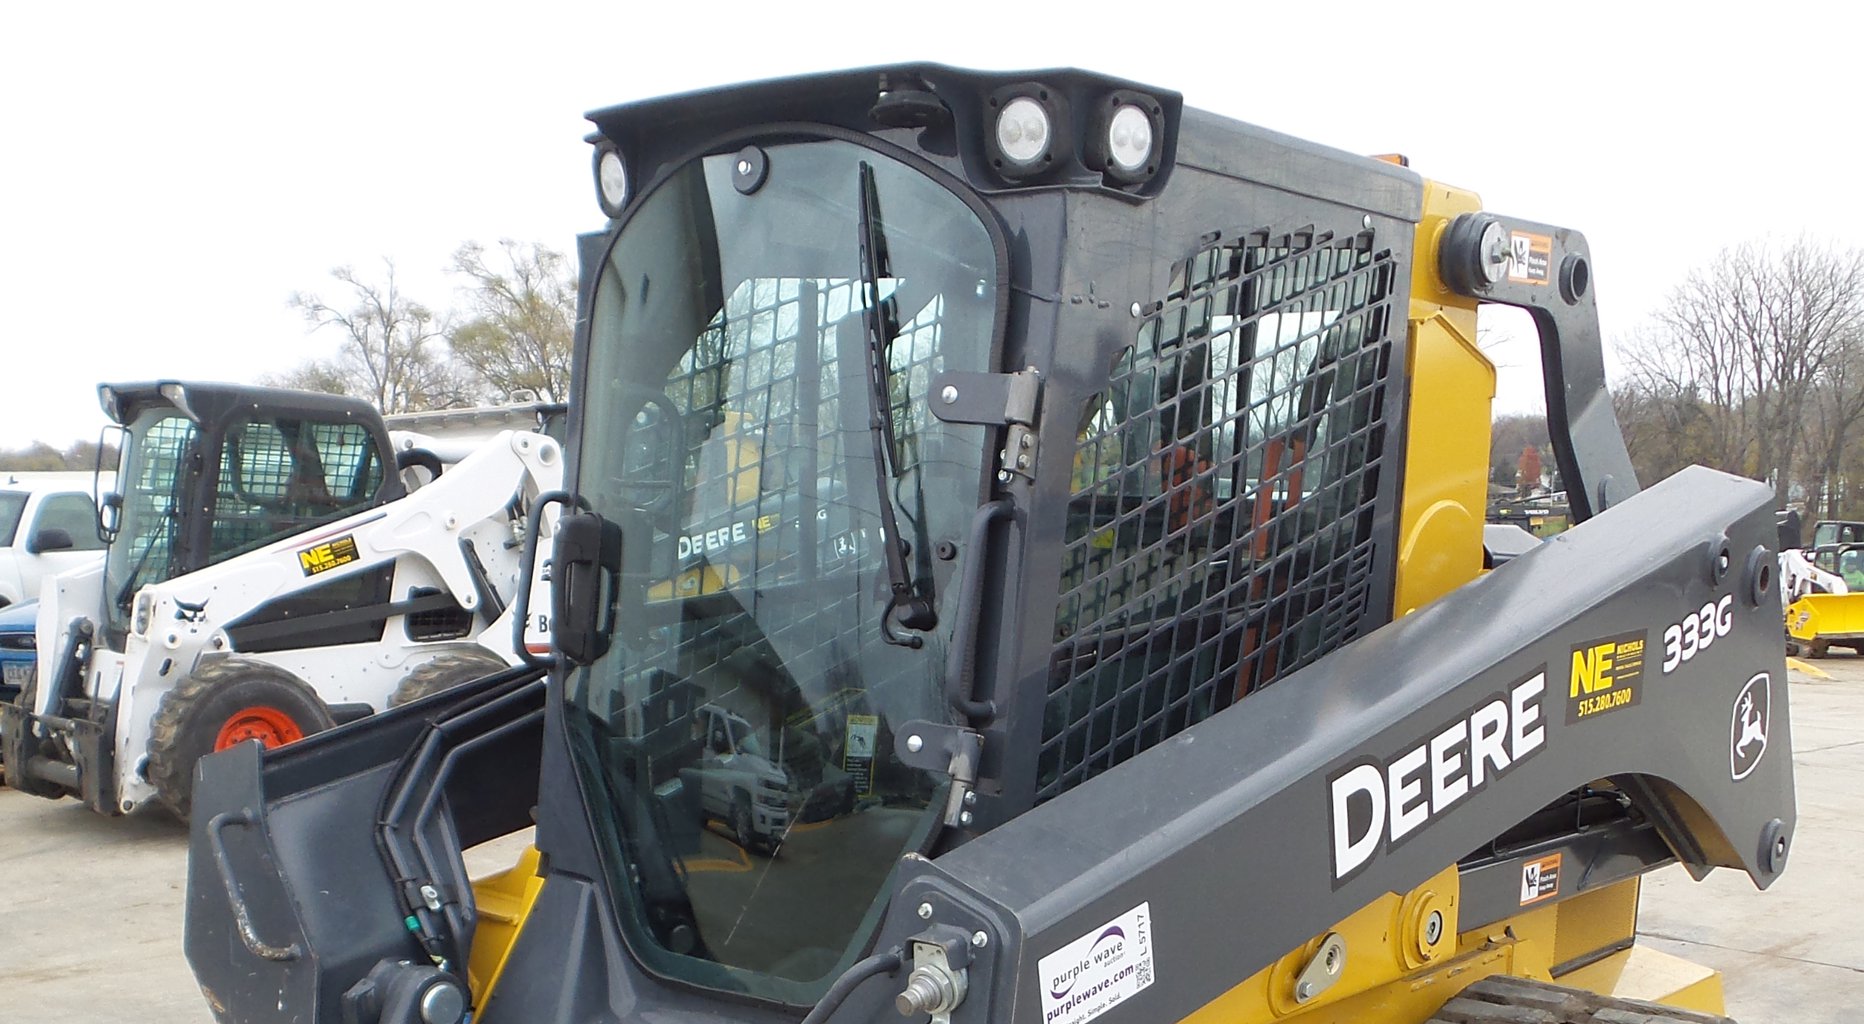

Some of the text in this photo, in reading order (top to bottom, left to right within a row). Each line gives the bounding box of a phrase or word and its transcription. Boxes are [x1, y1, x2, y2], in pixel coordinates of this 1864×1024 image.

[299, 543, 335, 569] NE
[678, 521, 747, 560] DEERE
[1663, 594, 1732, 673] 333G
[1569, 643, 1615, 698] NE
[1578, 687, 1632, 717] 515.280.7600
[1331, 671, 1545, 879] DEERE
[1136, 914, 1146, 945] 5717
[1053, 941, 1123, 990] purple wave
[1103, 953, 1123, 968] auction
[1087, 1002, 1108, 1017] Simple.
[1108, 991, 1122, 1005] Sold.
